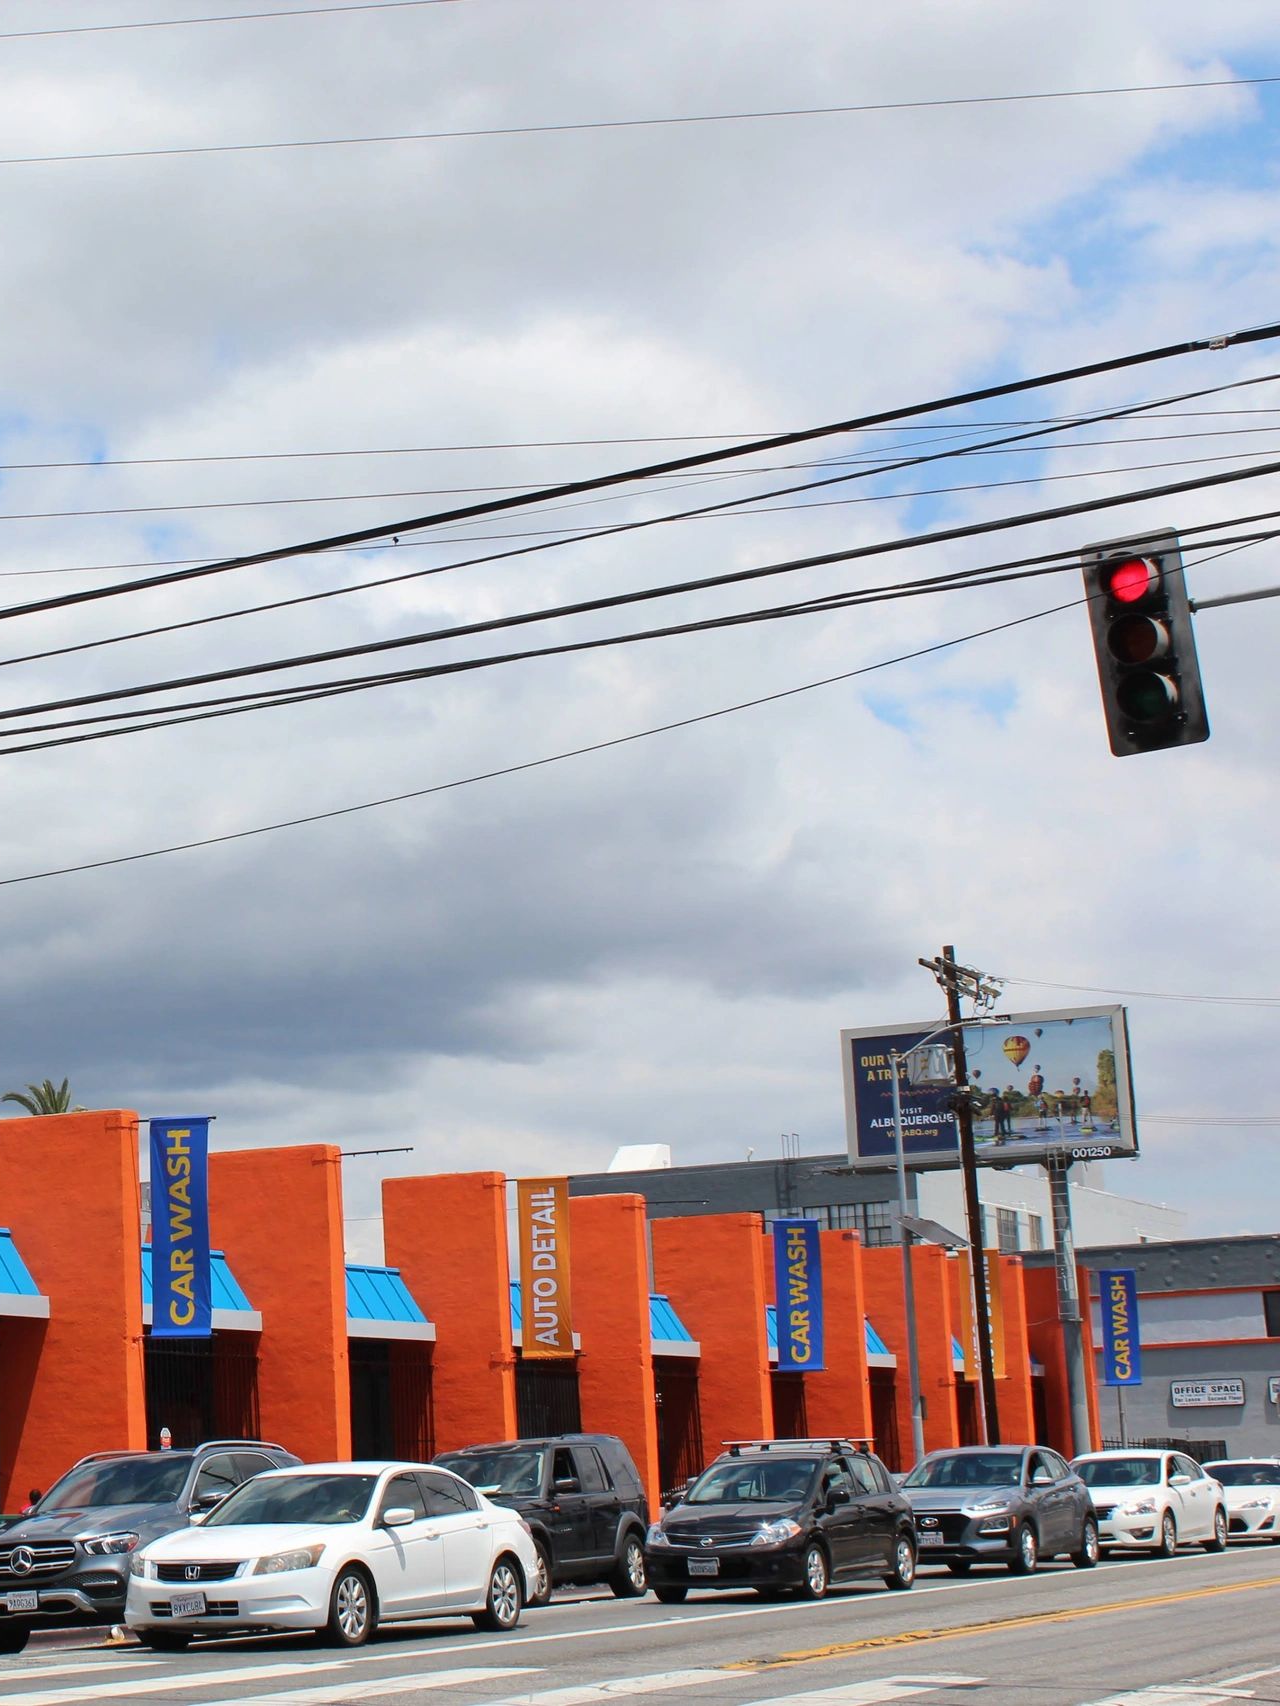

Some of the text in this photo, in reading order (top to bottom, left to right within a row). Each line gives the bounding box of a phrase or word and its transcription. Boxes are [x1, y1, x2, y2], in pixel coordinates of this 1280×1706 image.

[861, 1055, 885, 1067] OUR
[886, 1129, 938, 1139] ViABQ.org
[1072, 1146, 1111, 1158] 001250
[166, 1128, 195, 1326] CAR WASH
[530, 1186, 560, 1347] AUTO DETAIL
[786, 1228, 811, 1364] CAR WASH
[1110, 1276, 1132, 1380] CAR WASH
[1174, 1384, 1241, 1394] OFFICE SPACE
